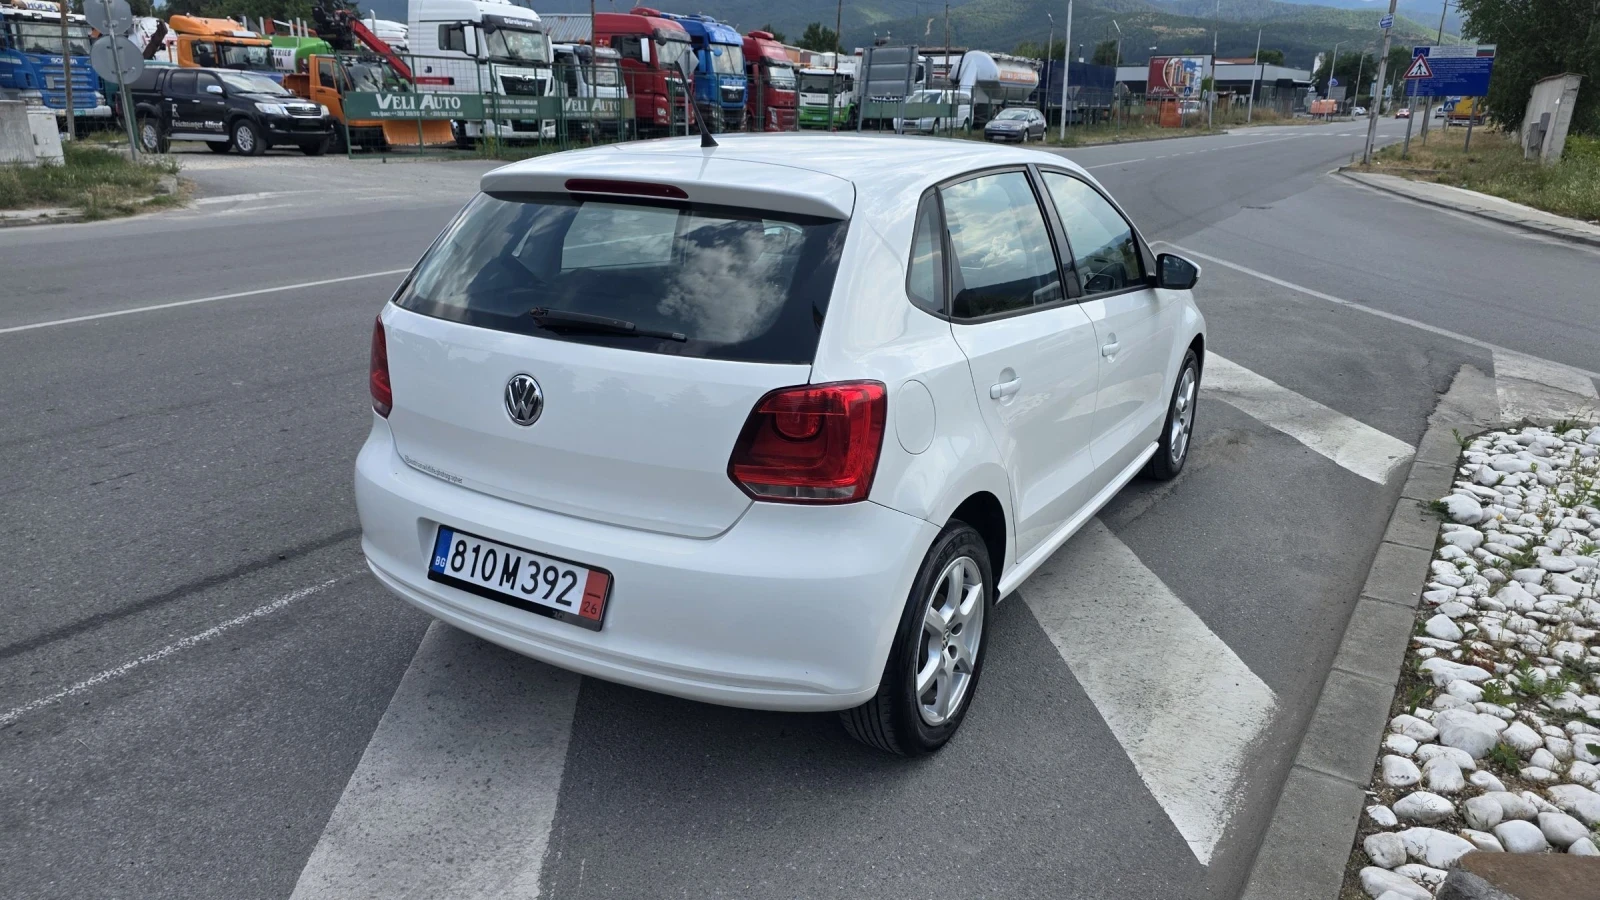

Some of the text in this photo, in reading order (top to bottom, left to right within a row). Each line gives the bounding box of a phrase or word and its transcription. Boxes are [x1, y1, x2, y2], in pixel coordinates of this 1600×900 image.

[375, 93, 461, 110] VELI AUTO
[561, 97, 588, 112] VELI
[434, 555, 446, 568] BG
[583, 601, 597, 615] 26
